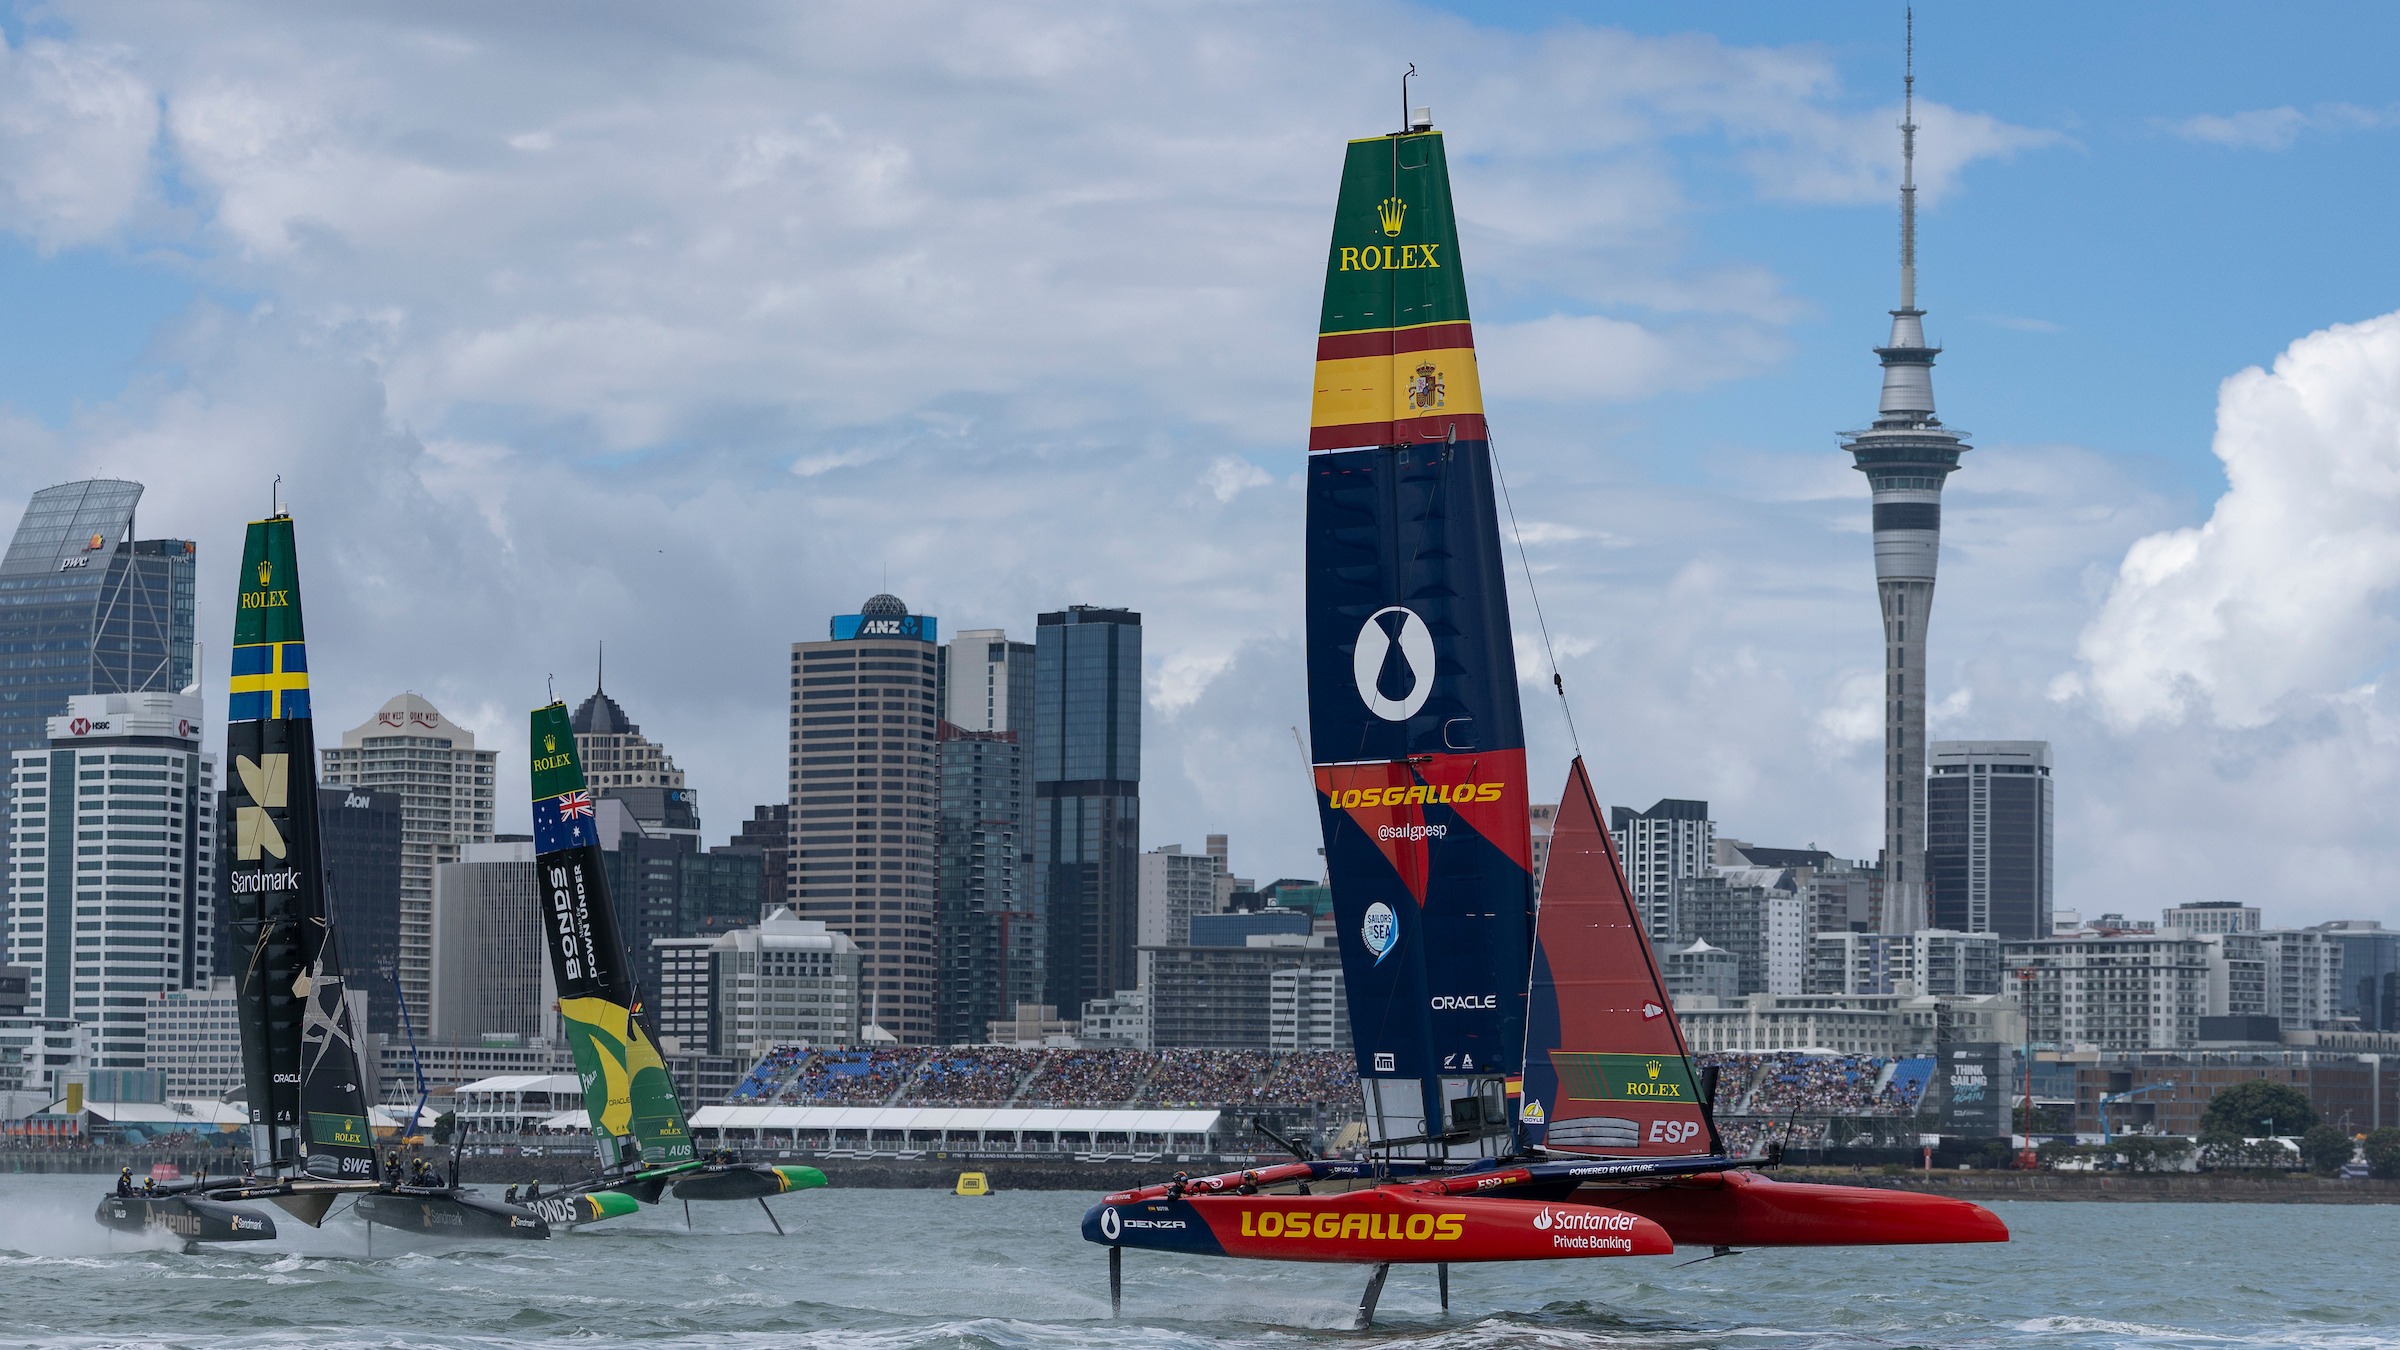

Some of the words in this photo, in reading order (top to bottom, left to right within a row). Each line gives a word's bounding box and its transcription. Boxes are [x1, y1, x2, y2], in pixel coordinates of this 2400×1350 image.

[1340, 244, 1440, 271] ROLEX
[59, 556, 88, 572] pwc
[241, 590, 288, 609] ROLEX
[863, 620, 900, 634] ANZ
[379, 712, 391, 721] QUAY
[392, 711, 404, 720] WEST
[410, 711, 423, 720] QUAY
[426, 712, 438, 721] WEST
[92, 721, 110, 730] HSBC
[533, 752, 571, 772] ROLEX
[1330, 782, 1505, 809] LOSGALLOS
[1377, 823, 1447, 842] @sailgpesp
[231, 866, 299, 893] Sandmark
[573, 864, 589, 920] UNDER
[551, 867, 578, 981] BONDS
[1367, 914, 1392, 924] SAILORS
[1373, 924, 1392, 939] SEA
[584, 923, 598, 978] DOWN
[1431, 995, 1497, 1010] ORACLE
[1954, 1064, 1983, 1075] THINK
[1950, 1075, 1988, 1086] SAILING
[1627, 1083, 1680, 1097] ROLEX
[1952, 1090, 1985, 1105] AGAIN
[335, 1132, 361, 1143] ROLEX
[1649, 1120, 1699, 1143] ESP
[669, 1144, 691, 1156] AUS
[342, 1157, 372, 1174] SWE
[1569, 1166, 1607, 1175] POWERED
[1609, 1165, 1620, 1173] BY
[1477, 1177, 1502, 1190] ESP
[145, 1201, 200, 1234] Artemis
[237, 1217, 263, 1230] Sandmark
[431, 1209, 463, 1226] Sandmark
[516, 1217, 536, 1228] Sandmark
[1123, 1219, 1186, 1229] DENZA
[1554, 1211, 1638, 1231] Santander
[1241, 1211, 1467, 1240] LOSGALLOS
[1553, 1235, 1588, 1248] Private
[1590, 1236, 1631, 1252] Banking
